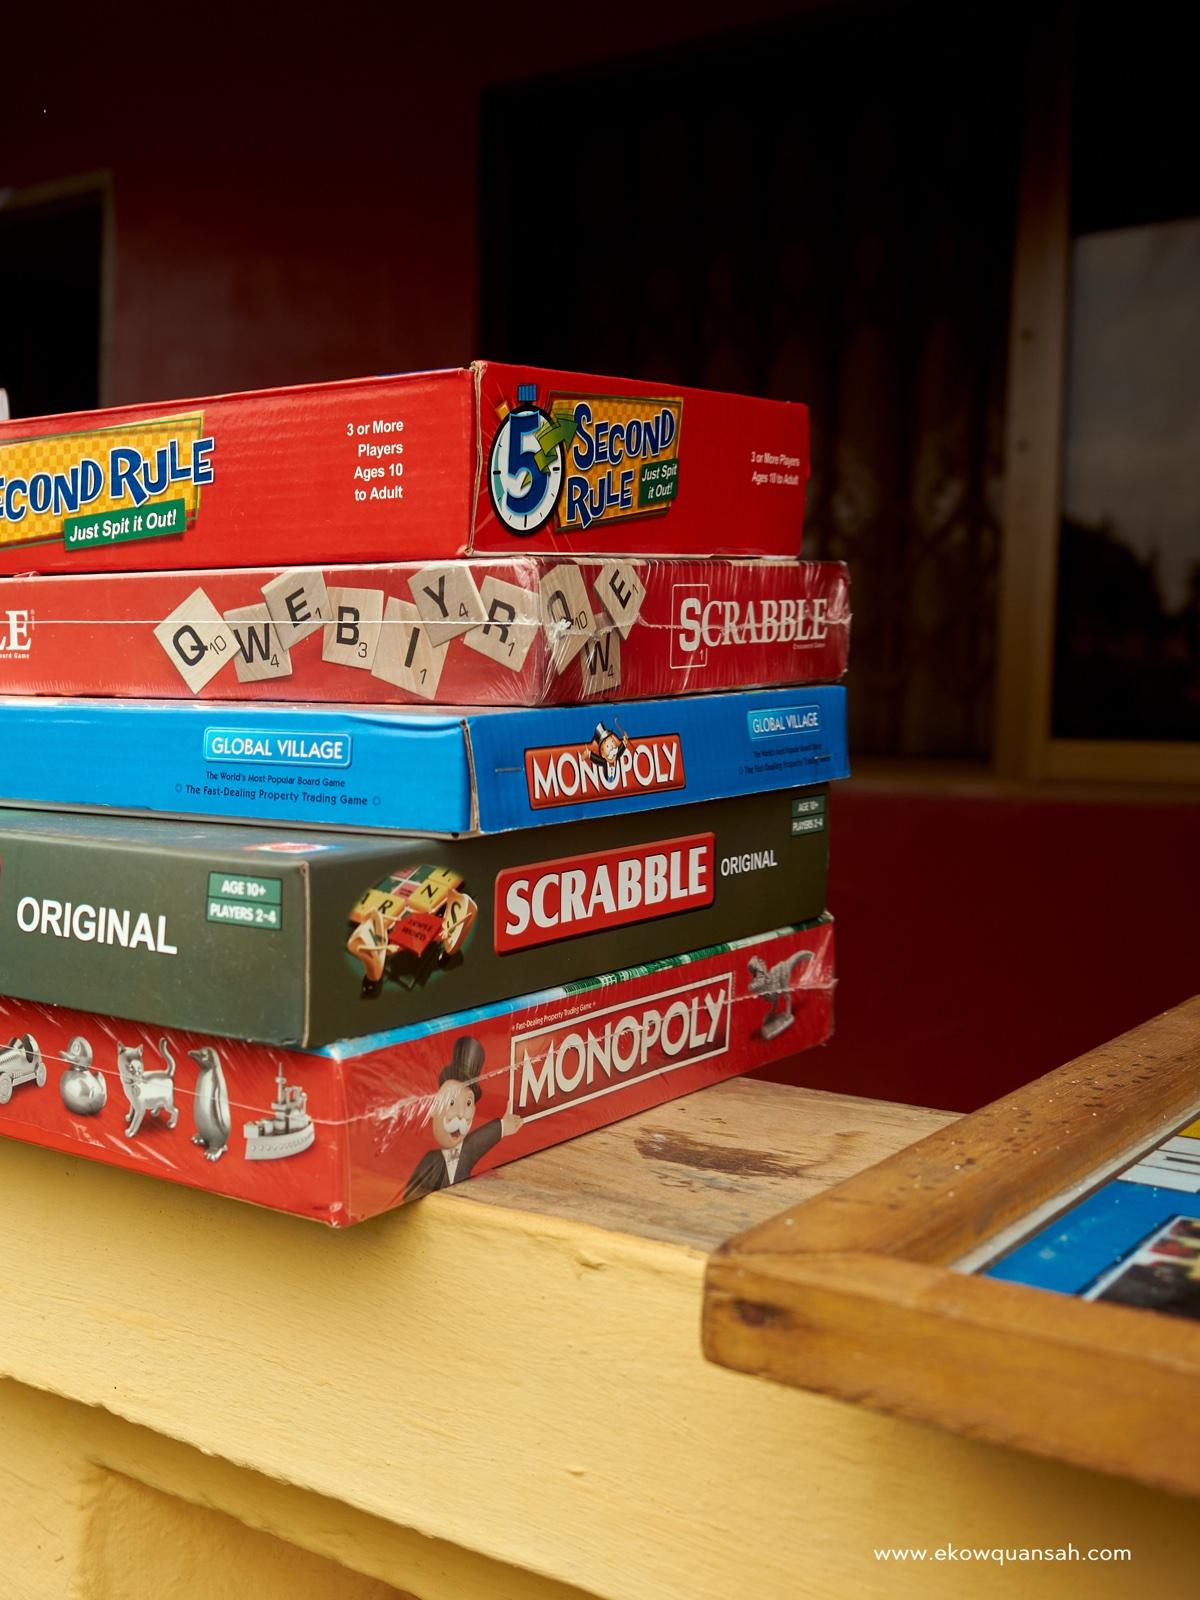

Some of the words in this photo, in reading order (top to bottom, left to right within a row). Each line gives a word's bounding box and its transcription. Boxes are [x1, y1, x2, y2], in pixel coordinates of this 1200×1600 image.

[346, 423, 354, 437] 3
[357, 424, 370, 435] or
[372, 420, 404, 434] More
[358, 443, 404, 459] Players
[506, 409, 550, 516] 5
[573, 401, 676, 471] SECOND
[109, 437, 215, 508] RULE
[353, 466, 385, 482] Ages
[389, 463, 403, 477] 10
[642, 468, 660, 482] Just
[661, 463, 678, 480] Spit
[354, 488, 366, 501] to
[369, 485, 404, 500] Adult
[566, 467, 634, 529] RULE
[647, 485, 654, 500] it
[655, 482, 674, 498] Out!
[69, 523, 100, 543] Just
[102, 518, 129, 540] Spit
[132, 516, 144, 532] it
[146, 509, 178, 530] Out!
[422, 574, 449, 619] Y
[458, 603, 469, 618] 4
[609, 569, 632, 609] E
[284, 586, 313, 628] E
[314, 607, 322, 620] 1
[574, 611, 588, 631] 10
[679, 597, 829, 651] SCRABBLE
[336, 606, 360, 646] B
[358, 642, 368, 658] 3
[481, 598, 517, 644] R
[507, 641, 516, 657] 1
[14, 652, 30, 660] Game
[172, 623, 209, 667] Q
[208, 634, 227, 656] 10
[233, 623, 271, 664] W
[269, 653, 281, 668] 4
[403, 626, 421, 669] I
[419, 668, 428, 685] 1
[584, 634, 611, 676] W
[607, 667, 614, 678] 4
[752, 716, 785, 733] GLOBAL
[785, 712, 819, 729] VILLAGE
[211, 737, 272, 756] GLOBAL
[277, 739, 343, 760] VILLAGE
[185, 784, 201, 794] The
[203, 785, 256, 800] Fast-Dealing
[259, 788, 299, 802] Property
[301, 791, 337, 805] Trading
[339, 794, 368, 806] Game
[206, 771, 218, 780] The
[248, 774, 266, 783] Most
[267, 775, 295, 785] Popular
[298, 776, 320, 786] Board
[322, 778, 345, 788] Game
[720, 850, 778, 877] ORIGINAL
[221, 880, 245, 894] AGE
[246, 882, 267, 896] 10+
[505, 846, 707, 936] SCRABBLE
[210, 903, 254, 922] PLAYERS
[255, 908, 277, 924] 2-4
[378, 899, 393, 915] R
[16, 896, 178, 955] ORIGINAL
[519, 988, 726, 1109] MONOPOLY
